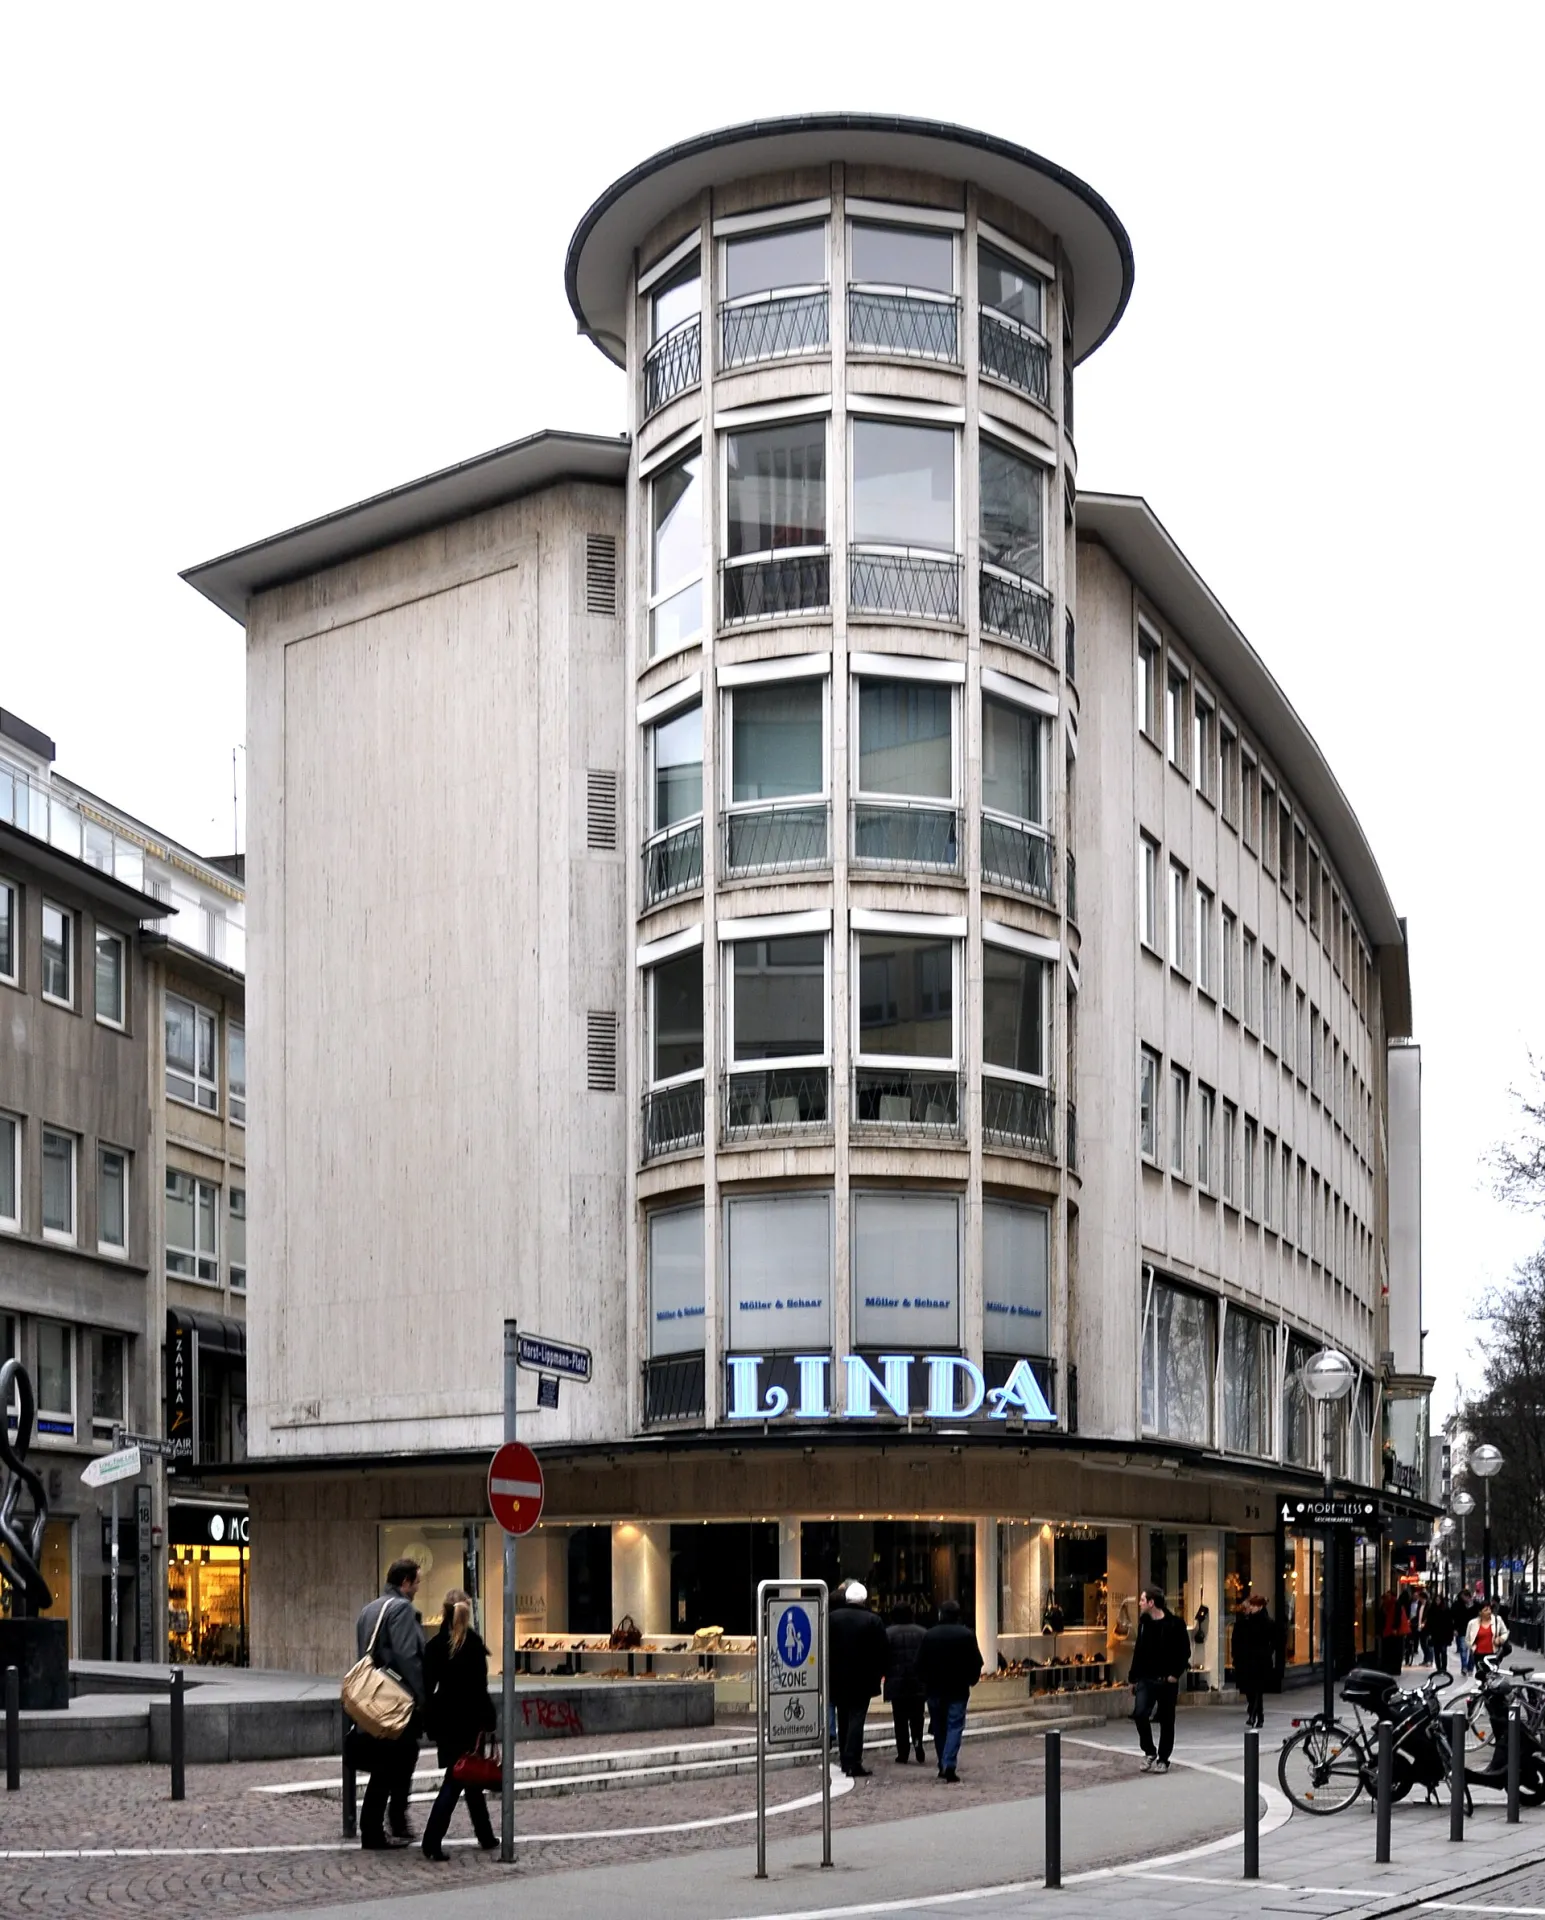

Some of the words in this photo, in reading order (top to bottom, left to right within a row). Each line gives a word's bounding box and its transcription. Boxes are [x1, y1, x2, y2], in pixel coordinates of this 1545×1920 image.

[739, 1300, 771, 1311] Möller
[775, 1300, 784, 1309] &
[787, 1298, 822, 1309] Schaar
[865, 1297, 899, 1308] Möller
[902, 1298, 911, 1307] &
[914, 1297, 950, 1309] Schaar
[175, 1339, 184, 1404] ZAHRA
[727, 1355, 1058, 1422] LINDA
[139, 1508, 149, 1523] 18
[1307, 1502, 1335, 1515] MORE
[781, 1671, 808, 1688] ZONE
